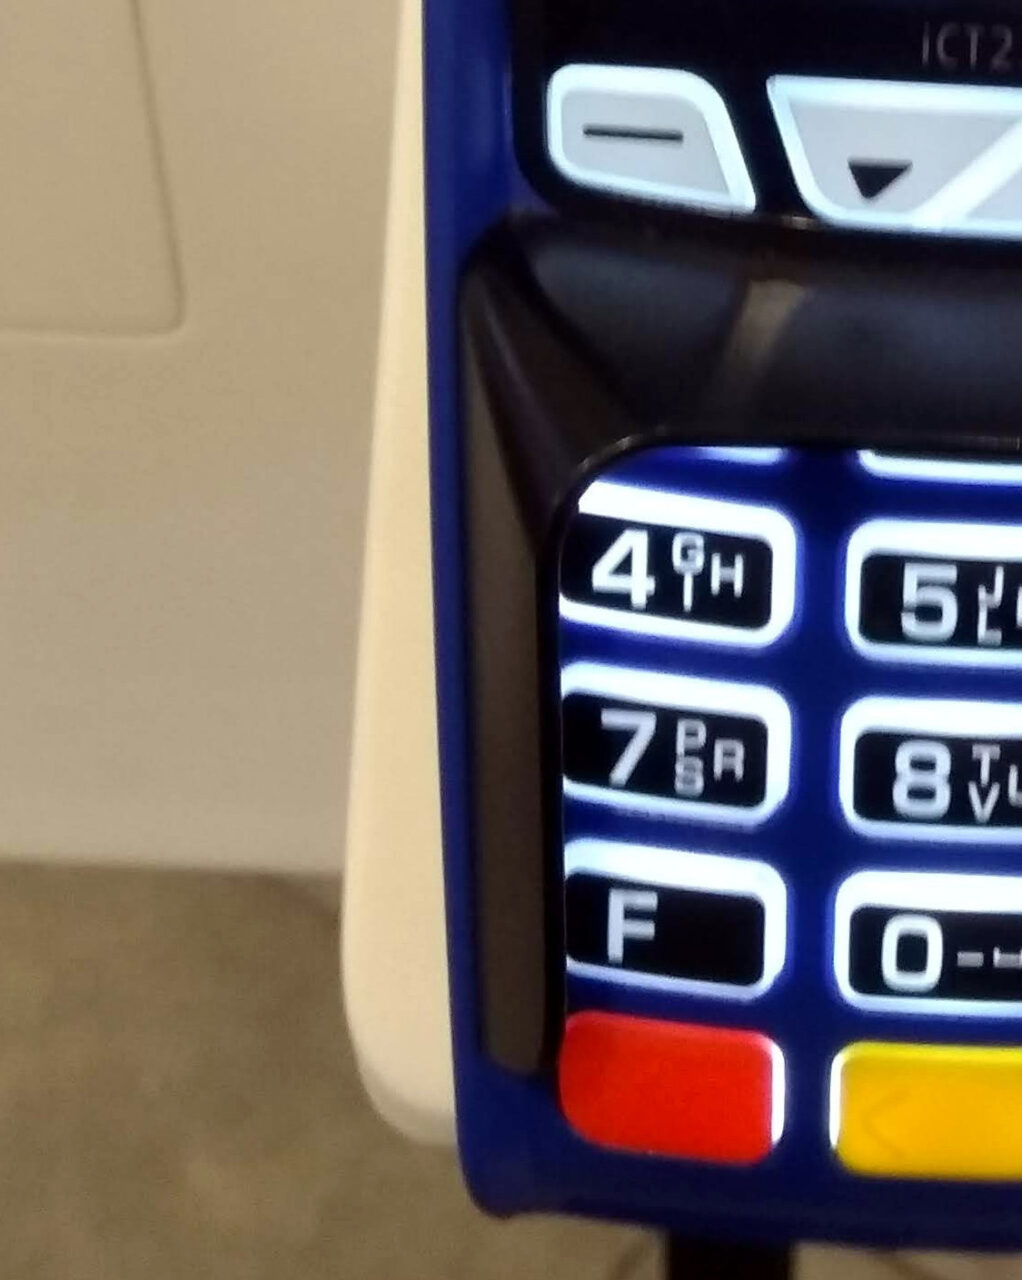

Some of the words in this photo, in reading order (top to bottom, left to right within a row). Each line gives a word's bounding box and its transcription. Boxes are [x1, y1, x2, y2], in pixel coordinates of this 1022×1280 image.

[592, 529, 656, 610] 4
[901, 562, 958, 642] 5
[601, 708, 657, 787] 7
[893, 739, 951, 819] 8
[608, 889, 658, 964] F
[881, 914, 943, 992] 0
